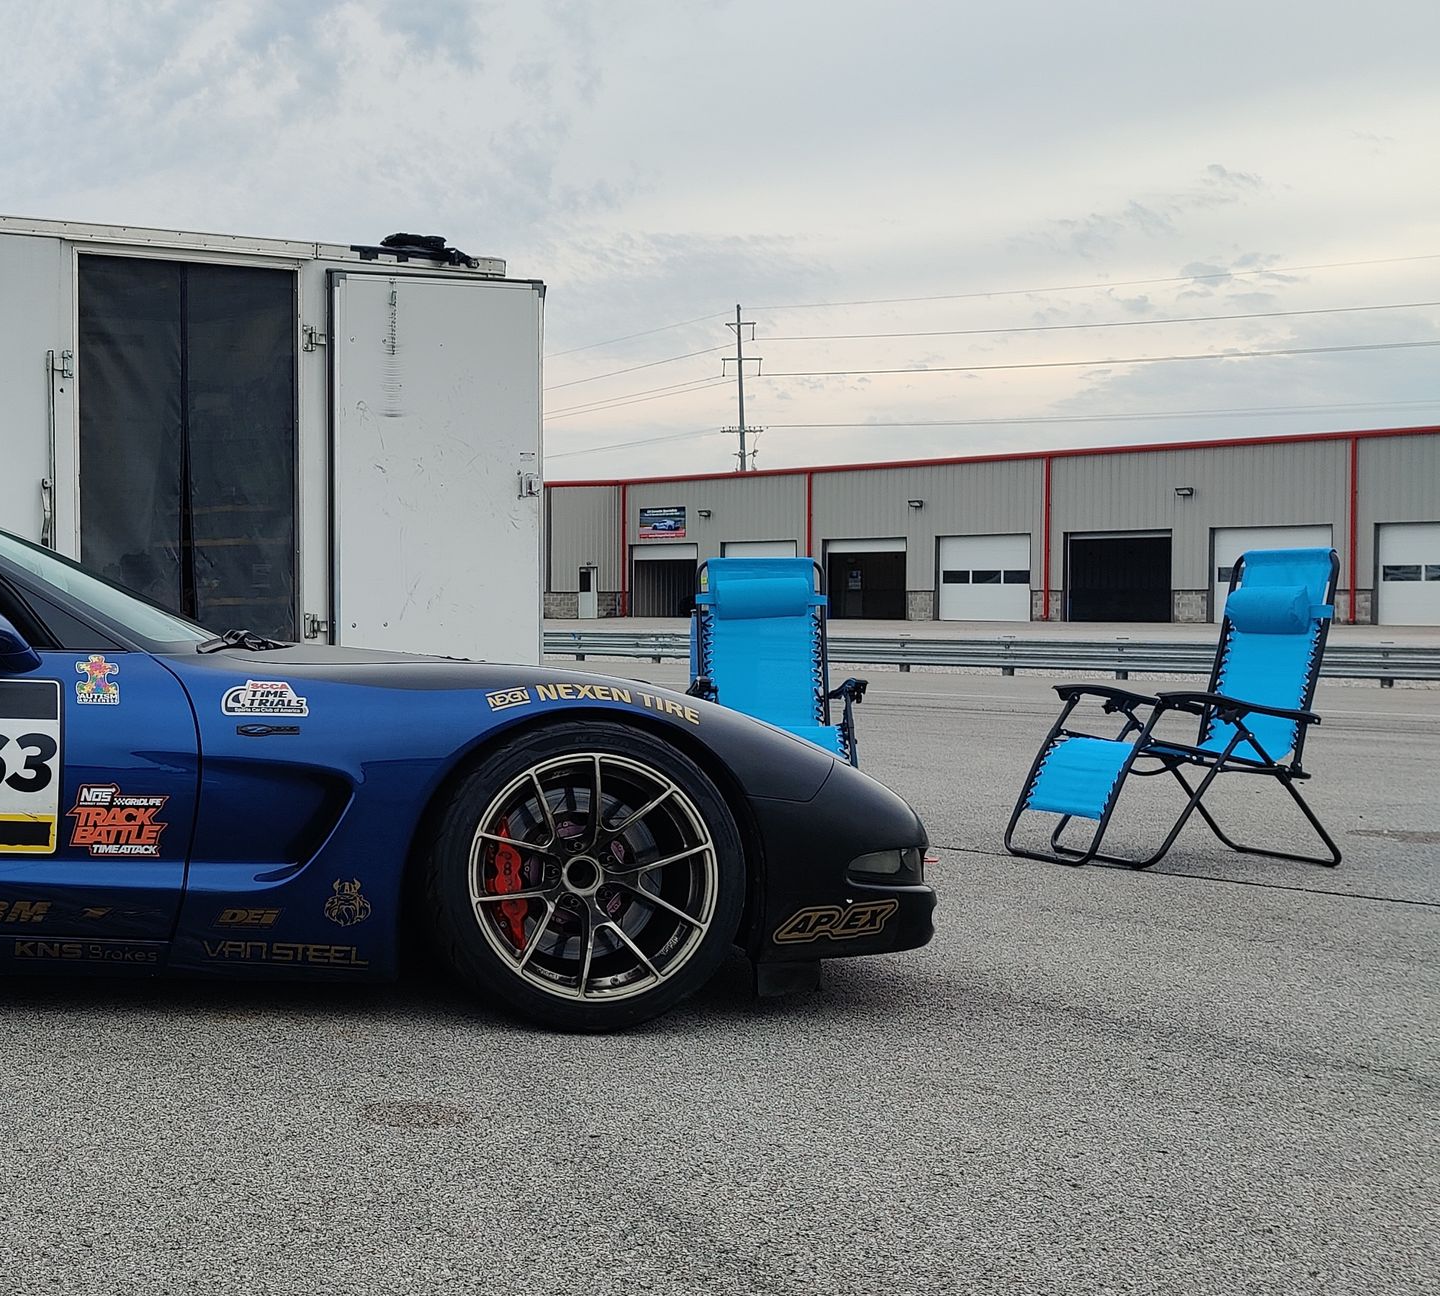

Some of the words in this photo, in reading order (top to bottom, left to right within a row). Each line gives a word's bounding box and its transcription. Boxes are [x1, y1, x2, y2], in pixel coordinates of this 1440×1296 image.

[248, 699, 304, 707] TRIALS
[249, 690, 288, 698] TIME
[535, 683, 632, 704] NEXEN
[637, 691, 701, 725] TIRE
[80, 787, 116, 802] NOS
[124, 798, 164, 806] GRIDLIFE
[73, 807, 157, 826] TRACK
[73, 825, 162, 844] BATTLE
[92, 844, 120, 854] TIME
[119, 845, 158, 854] ATTACK
[778, 904, 895, 939] APEX
[14, 942, 83, 959] KNS
[89, 944, 158, 962] Brakes
[271, 943, 369, 965] STEEL
